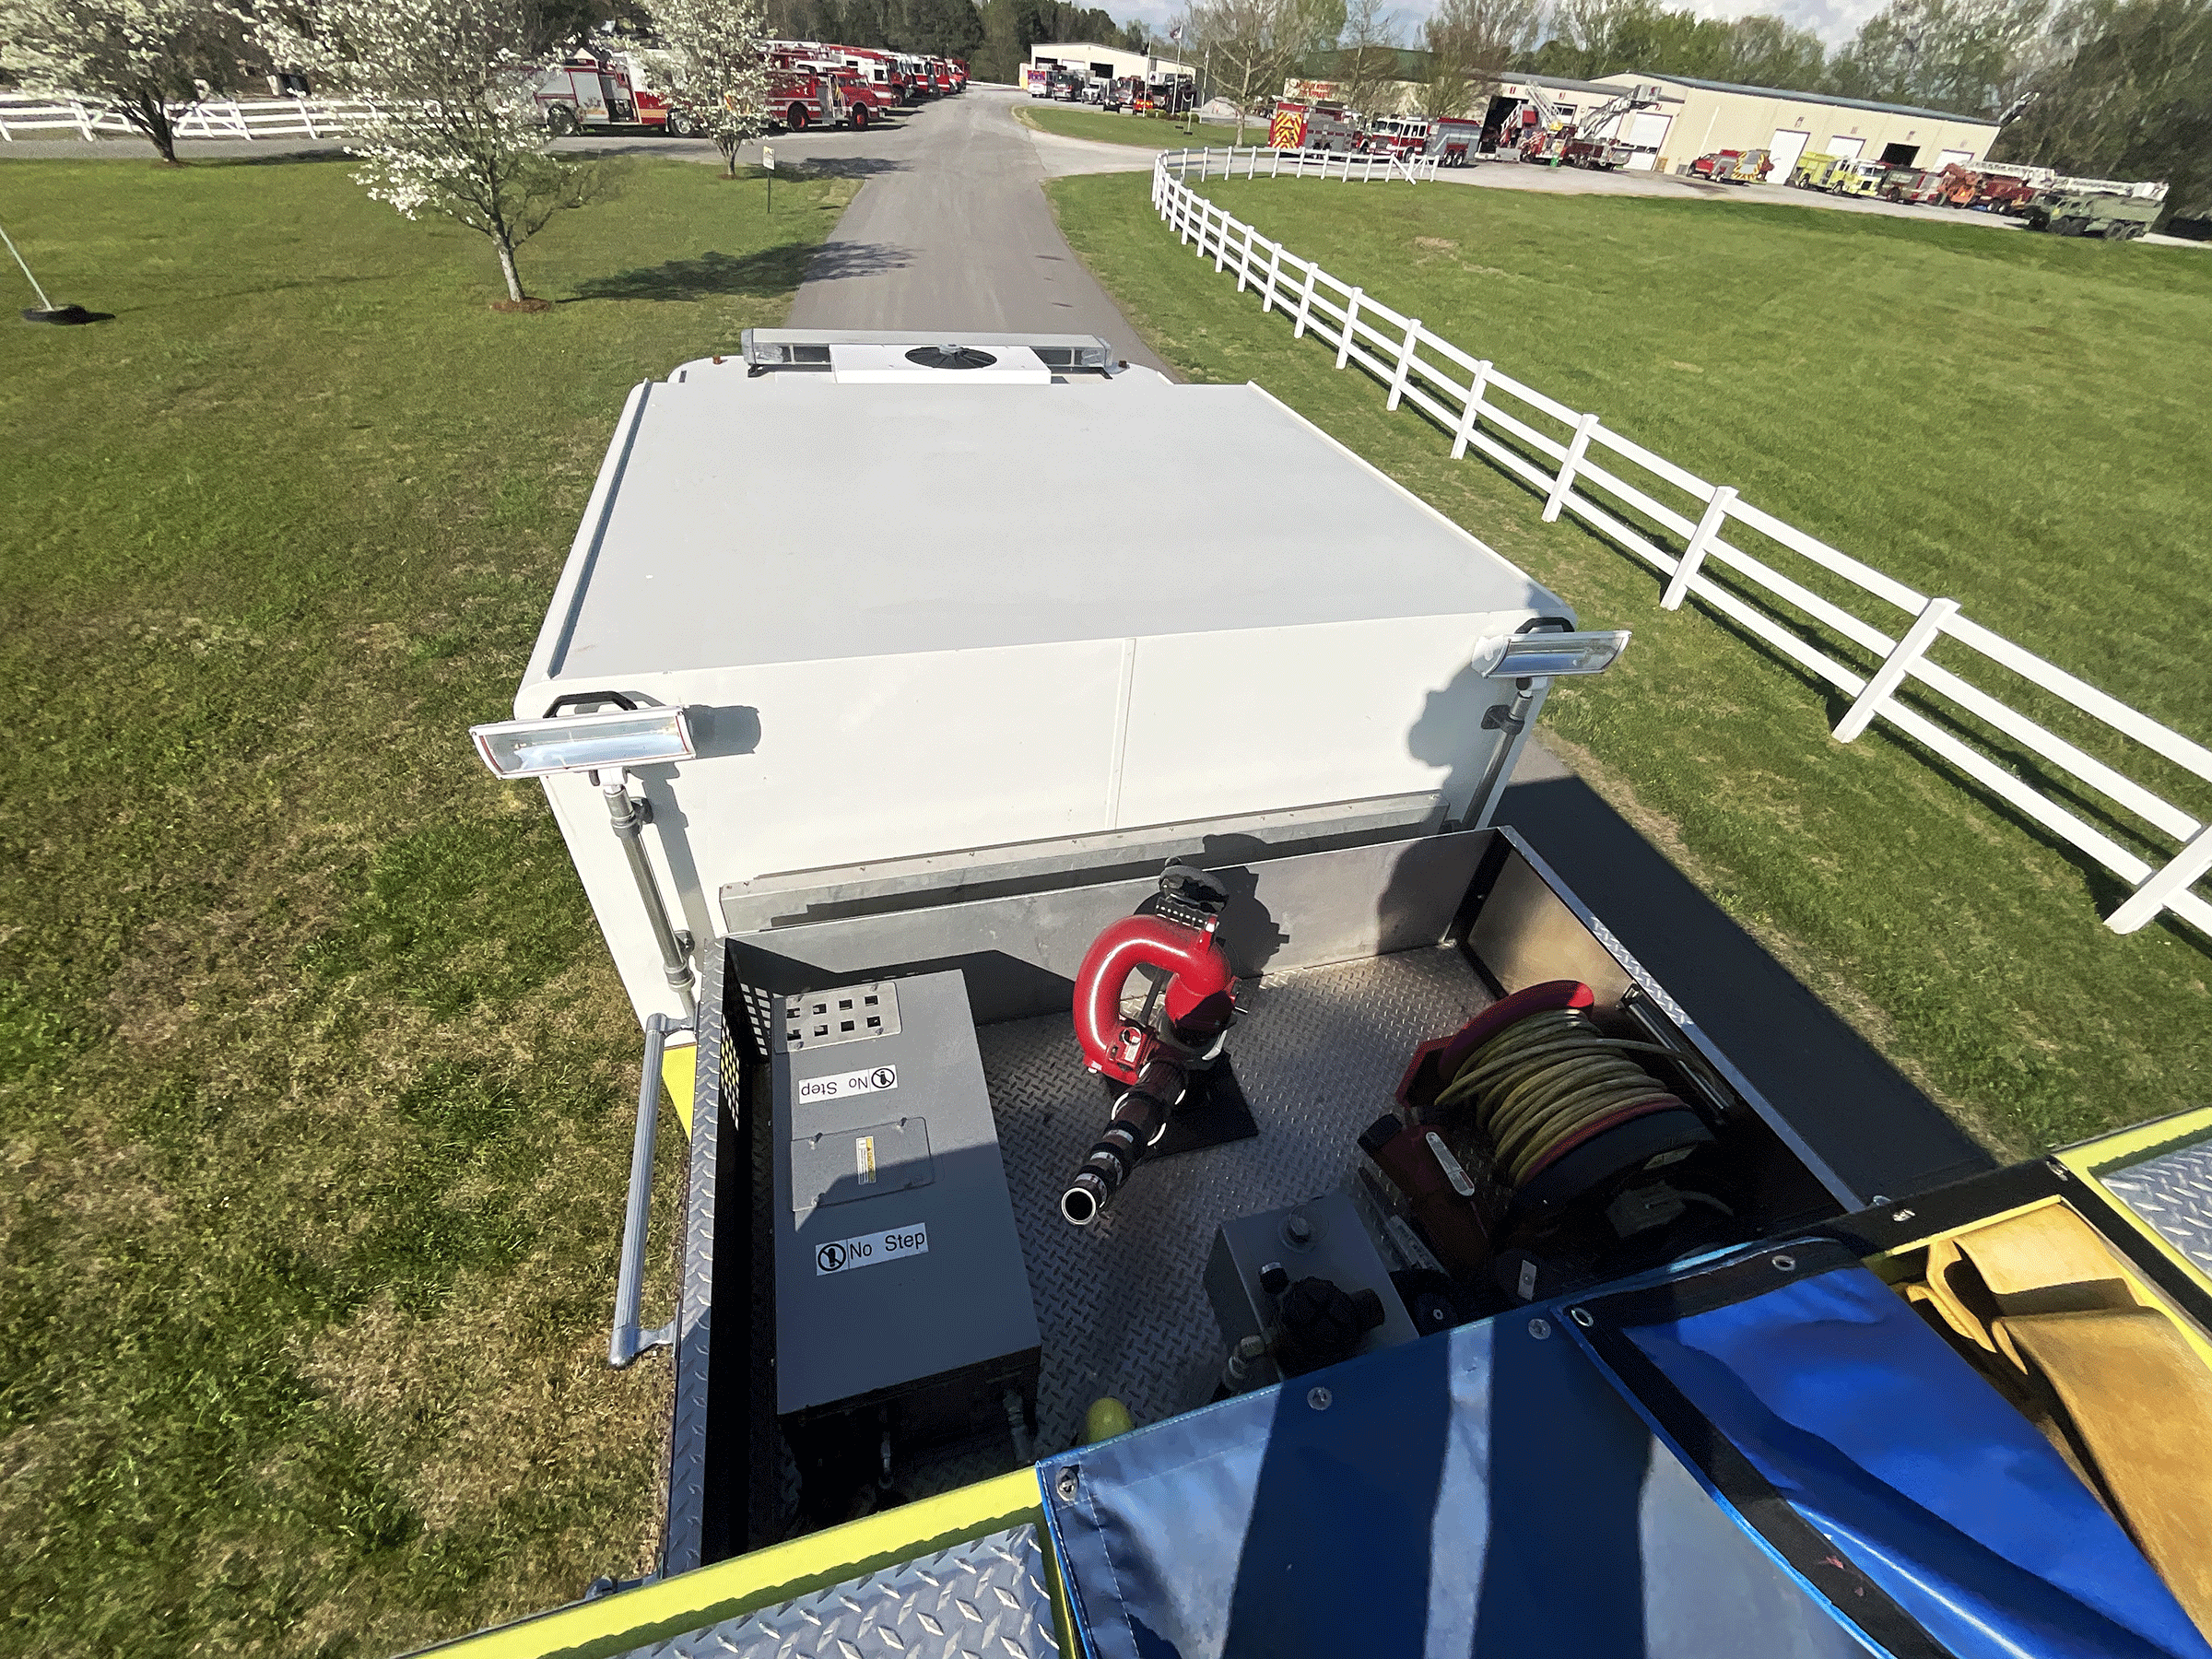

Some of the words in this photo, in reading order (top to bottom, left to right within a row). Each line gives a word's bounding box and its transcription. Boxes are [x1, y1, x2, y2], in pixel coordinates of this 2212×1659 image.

[801, 1081, 838, 1096] Step
[848, 1077, 868, 1089] No
[849, 1241, 872, 1260] No
[885, 1232, 925, 1252] Step
